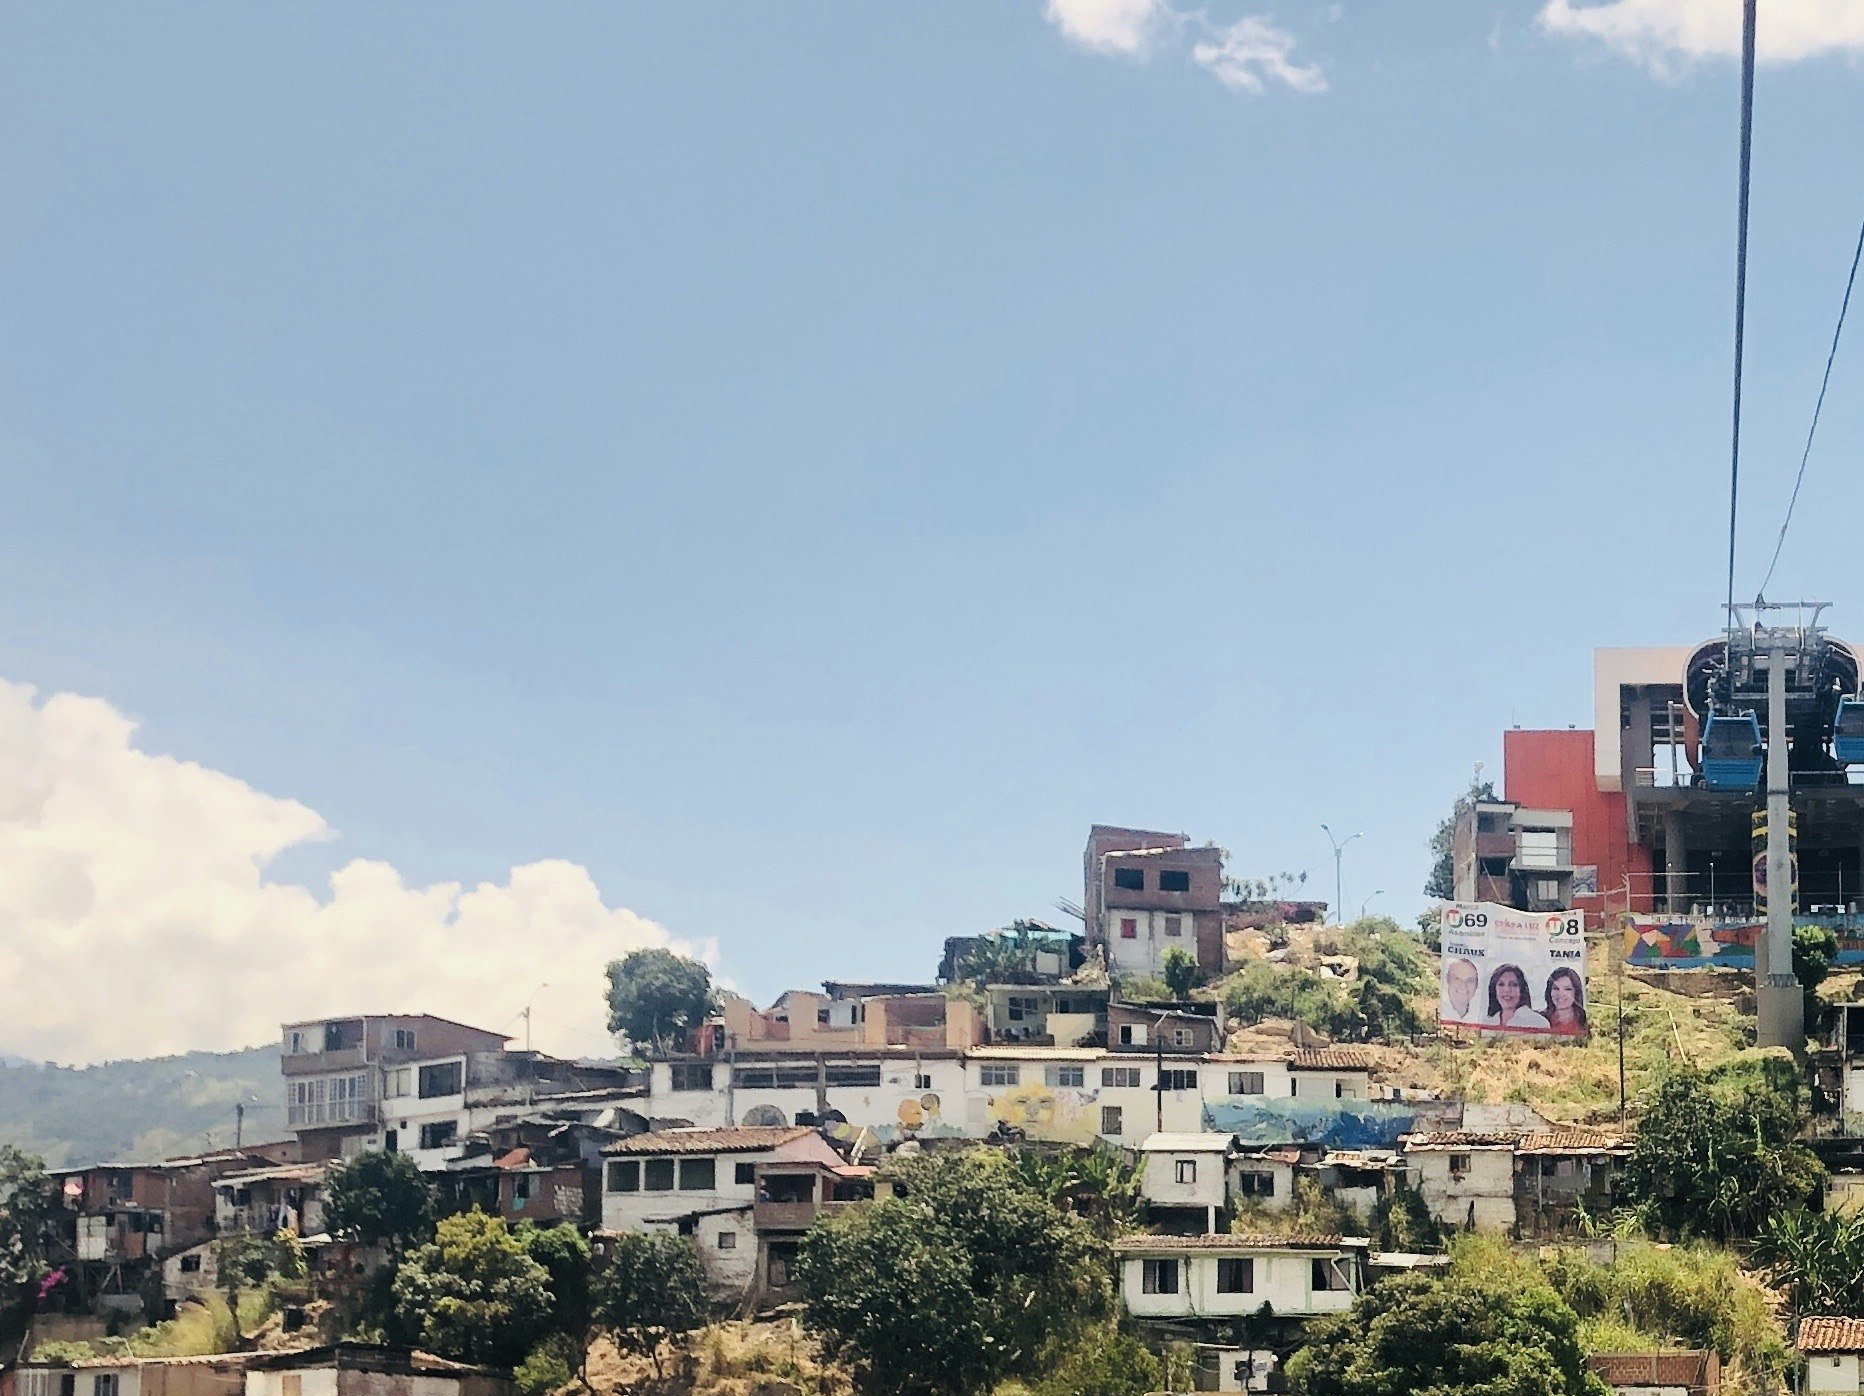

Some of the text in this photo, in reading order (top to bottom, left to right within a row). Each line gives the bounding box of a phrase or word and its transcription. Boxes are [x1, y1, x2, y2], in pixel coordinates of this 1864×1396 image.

[1465, 914, 1488, 928] 69
[1567, 919, 1579, 935] 8
[1550, 950, 1581, 958] TANIA
